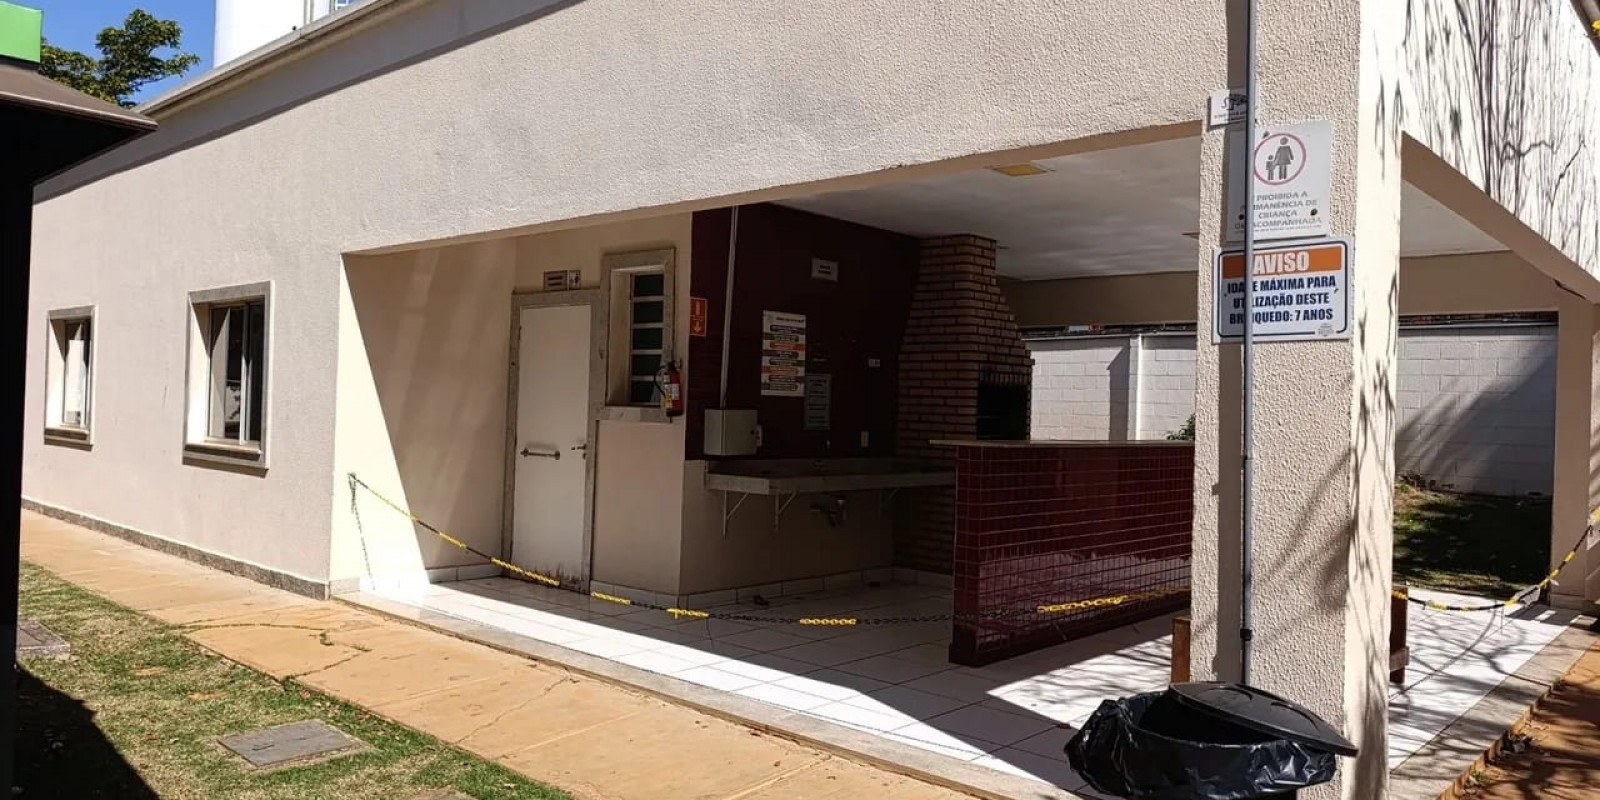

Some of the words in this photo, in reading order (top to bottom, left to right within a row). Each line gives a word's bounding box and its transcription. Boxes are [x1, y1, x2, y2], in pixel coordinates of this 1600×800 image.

[1257, 192, 1299, 201] PROIBIDA
[1235, 216, 1322, 230] DECOMPANHADA
[1258, 210, 1298, 219] CRIANÇA
[1253, 251, 1309, 275] AVISO
[1227, 281, 1257, 294] IDAE
[1260, 277, 1304, 292] MÁXIMA
[1307, 275, 1336, 288] PARA
[1233, 293, 1293, 309] UTIZAÇÃO
[1295, 292, 1329, 304] DESTE
[1229, 310, 1293, 325] BRQUEDO:
[1295, 310, 1301, 321] 7
[1303, 308, 1333, 320] ANOS
